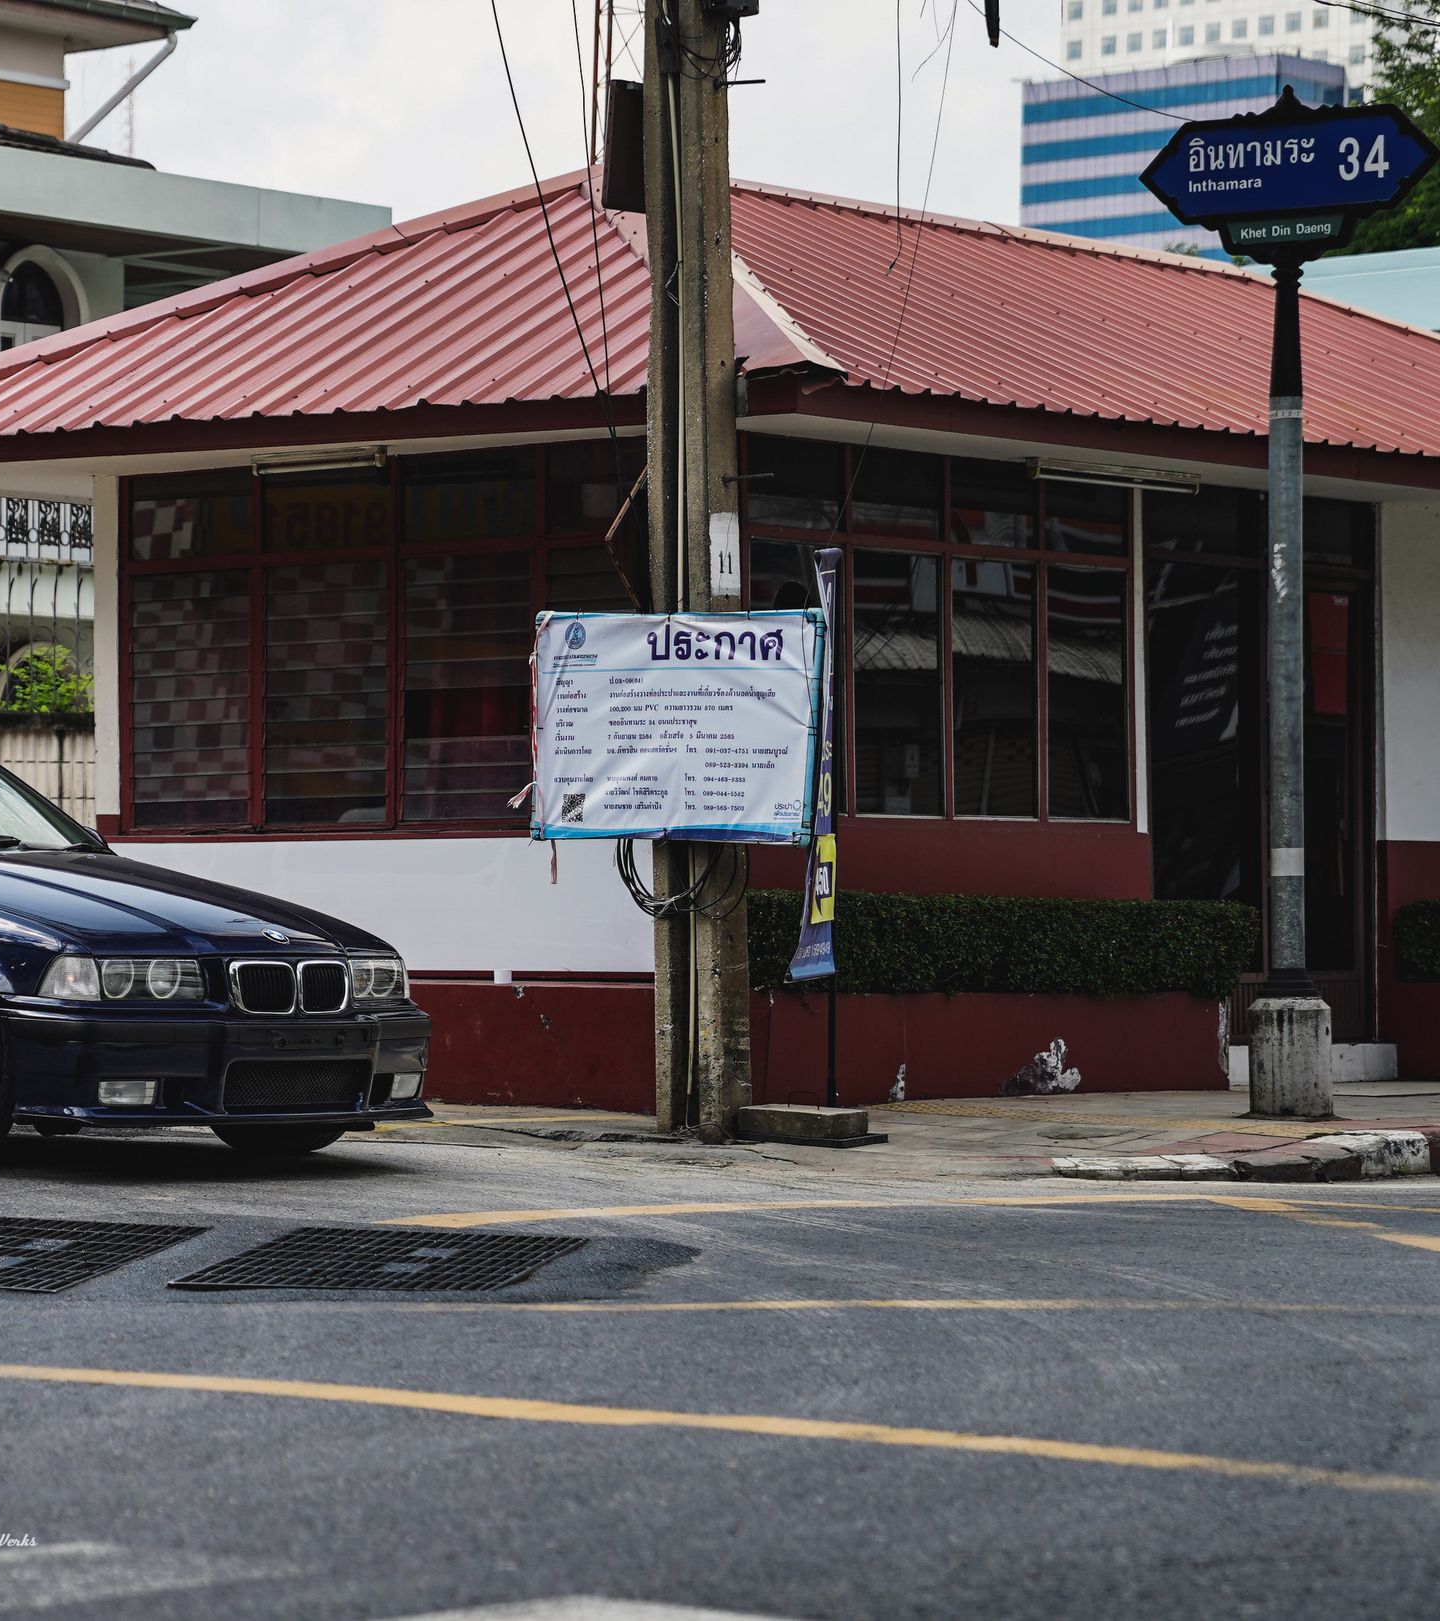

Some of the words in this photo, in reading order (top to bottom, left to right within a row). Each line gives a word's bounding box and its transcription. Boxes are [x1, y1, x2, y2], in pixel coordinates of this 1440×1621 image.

[1189, 137, 1315, 173] อินทามระ
[1338, 134, 1390, 181] 34
[1189, 178, 1262, 193] Inthamara
[1241, 227, 1267, 240] Khet
[1272, 225, 1291, 238] Din
[1296, 223, 1331, 238] Daeng
[719, 550, 732, 574] 11
[647, 624, 783, 660] ประกาศ
[557, 690, 586, 700] งานก่อสร้าง
[609, 718, 646, 726] ซอยอินทามระ
[614, 732, 636, 740] กันยายน
[696, 731, 717, 739] มีนาคม
